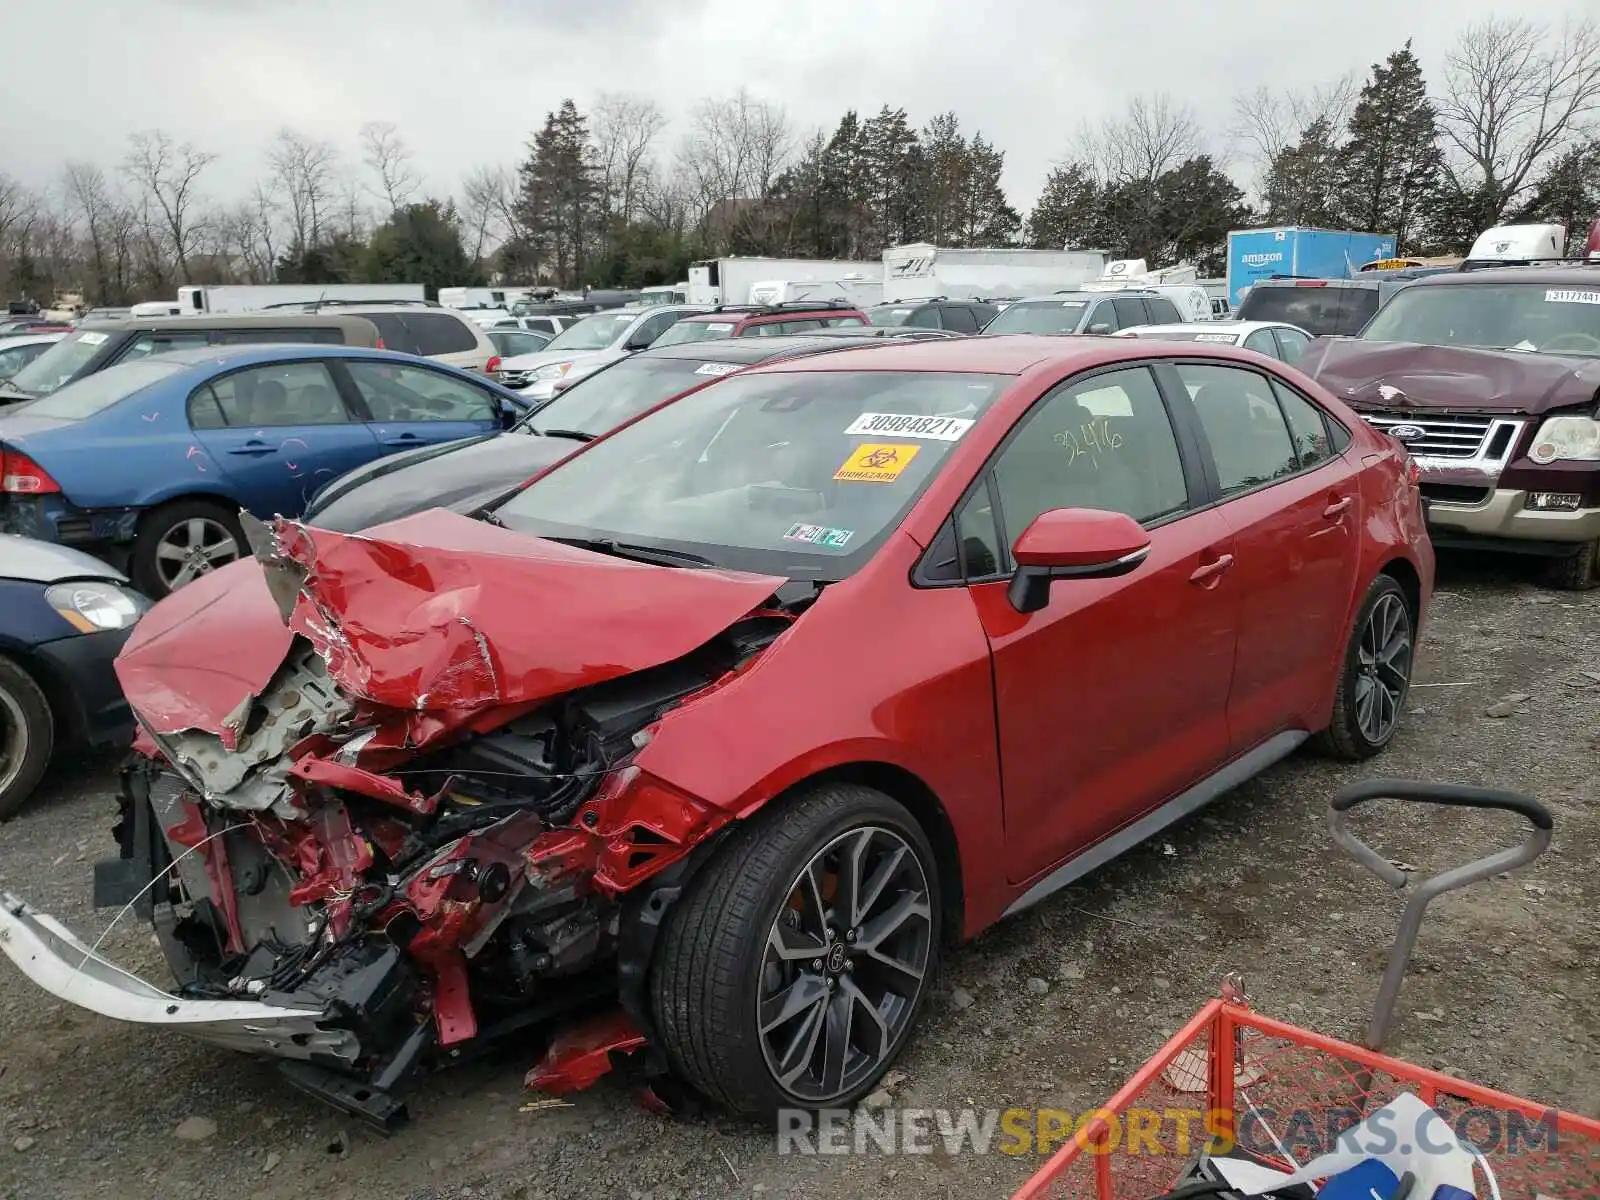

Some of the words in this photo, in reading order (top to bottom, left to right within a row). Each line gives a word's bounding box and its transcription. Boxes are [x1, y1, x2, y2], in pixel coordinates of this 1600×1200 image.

[1241, 251, 1283, 264] amazon
[863, 414, 955, 435] 30984821
[1394, 426, 1417, 437] Ford
[836, 470, 897, 481] BIOHAZARD
